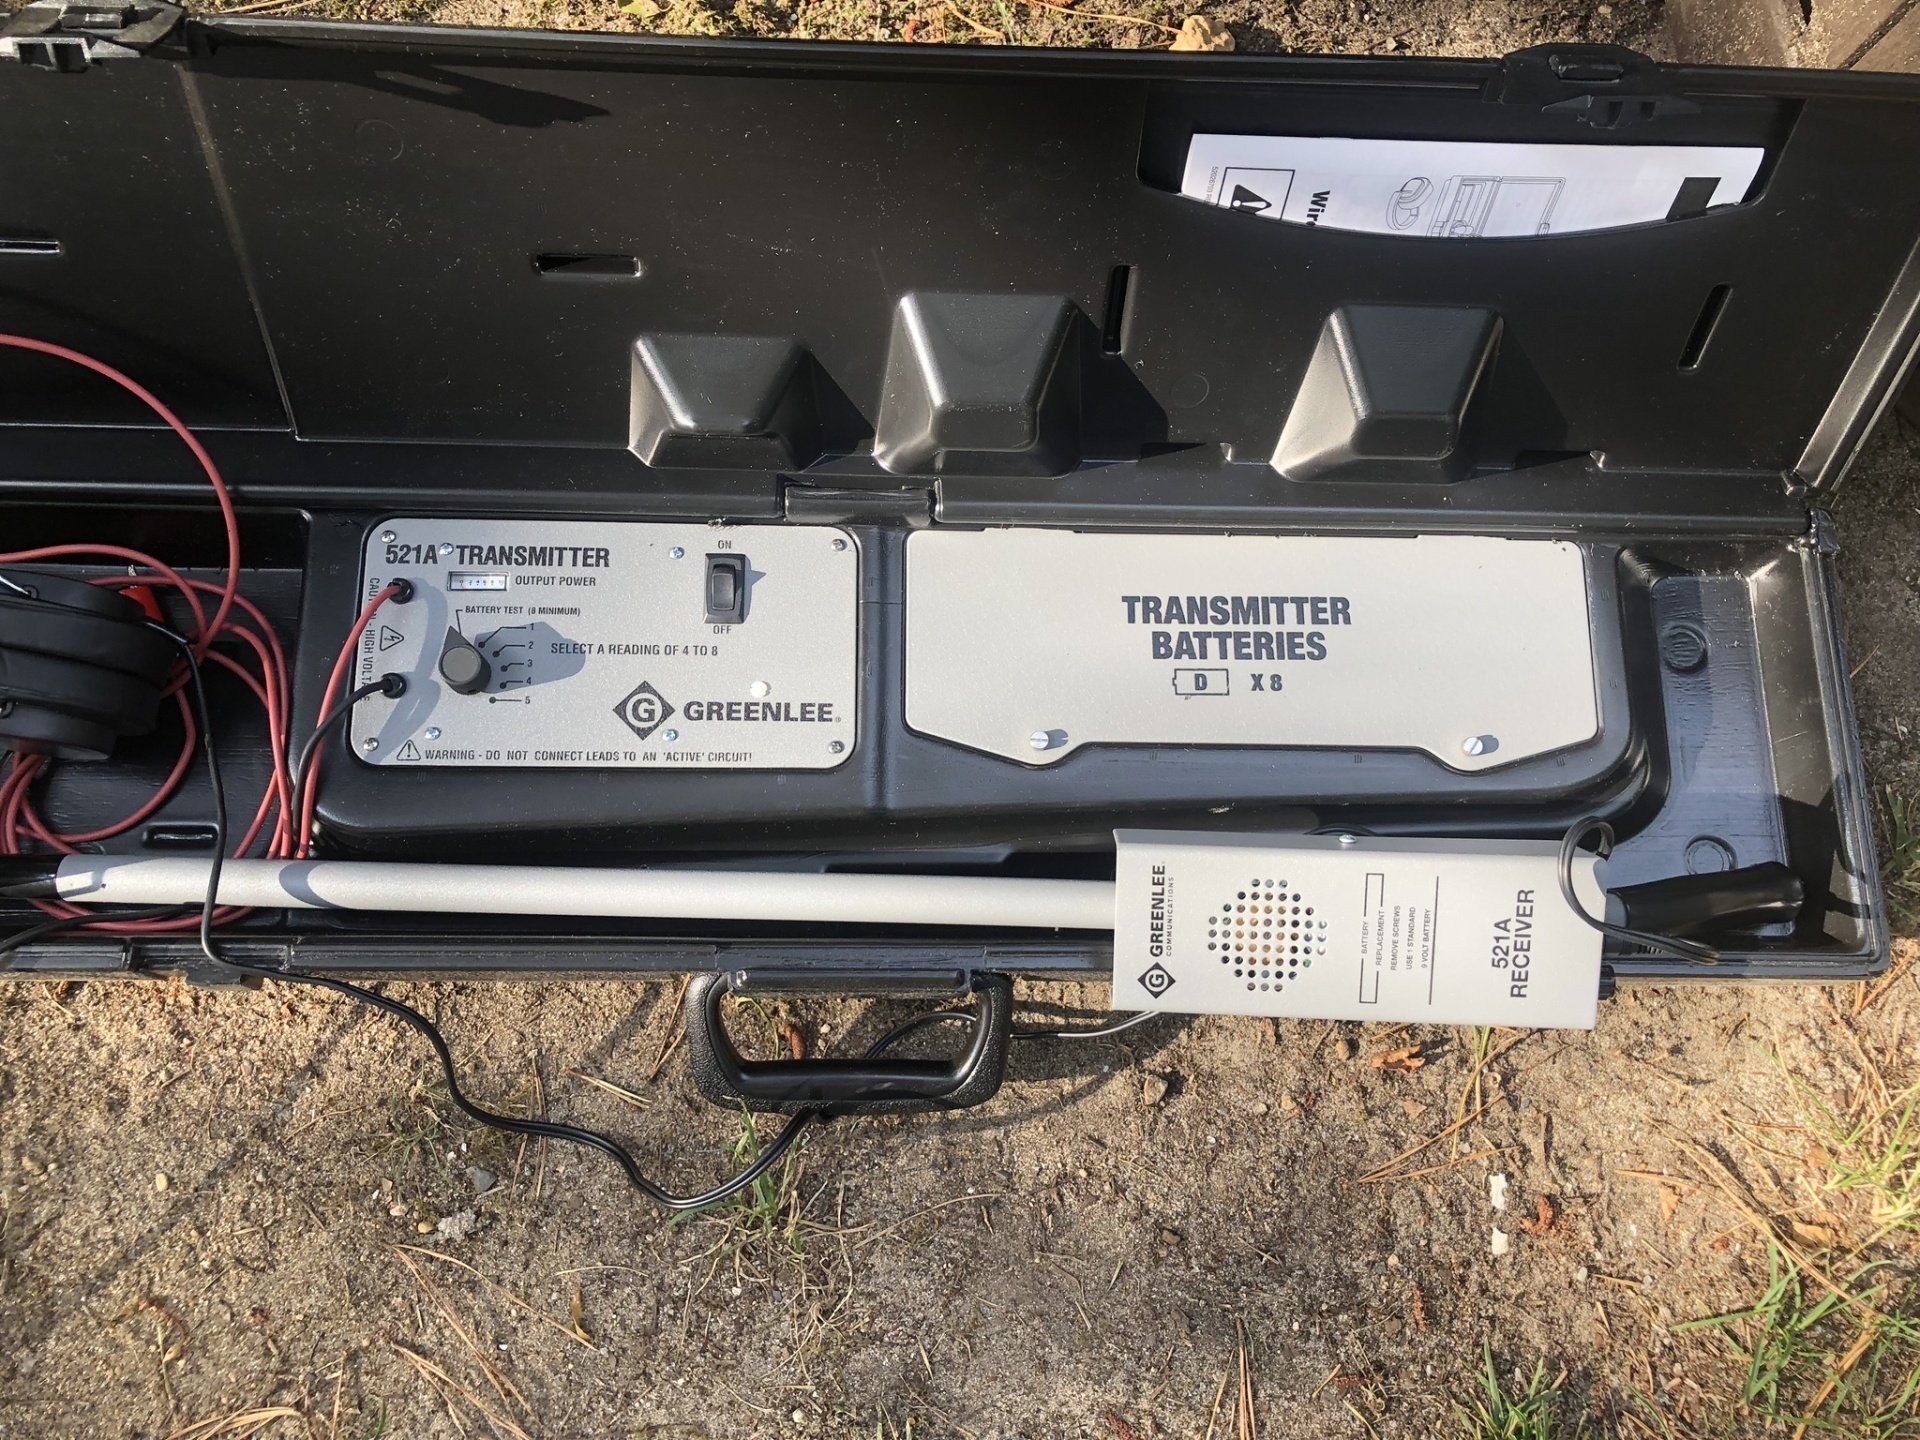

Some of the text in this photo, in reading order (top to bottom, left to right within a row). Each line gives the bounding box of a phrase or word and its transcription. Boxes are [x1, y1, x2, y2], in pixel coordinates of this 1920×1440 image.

[717, 540, 732, 550] ON
[385, 544, 609, 568] 521A TRANSMITTER
[515, 575, 597, 587] OUTPUT POWER
[465, 605, 581, 617] BATTERY TEST (8 MINIMUM)
[1121, 595, 1352, 625] TRANSMITTER
[529, 622, 535, 631] 1
[713, 624, 732, 635] OFF
[364, 629, 376, 654] HIGH
[528, 641, 534, 650] 2
[551, 642, 718, 657] SELECT A READING OF 4 TO 8
[1151, 631, 1328, 661] BATTERIES
[527, 659, 533, 668] 3
[526, 676, 532, 685] 4
[1194, 673, 1208, 691] D
[1250, 673, 1283, 692] X 8
[524, 696, 531, 705] 5
[631, 698, 656, 723] G
[683, 700, 834, 723] GREENLEE
[425, 749, 475, 761] WARNING
[485, 750, 501, 761] DO
[507, 750, 528, 761] NOT
[534, 750, 583, 761] CONNECT
[586, 750, 620, 762] LEADS
[623, 751, 637, 762] TO
[642, 751, 657, 762] AN
[663, 752, 705, 763] 'ACTIVE'
[707, 752, 752, 763] CIRCUIT!
[1149, 865, 1166, 957] GREENLEE
[1166, 876, 1174, 957] COMMUNICATIONS
[1407, 906, 1416, 948] STANDARD
[1422, 908, 1432, 942] BATTERY
[1361, 920, 1369, 955] BATTERY
[1376, 910, 1385, 966] REPLACEMENT
[1390, 905, 1401, 971] REMOVE SCREWS
[1491, 918, 1512, 969] 521A
[1510, 889, 1535, 998] RECEIVER
[1406, 955, 1414, 970] USE
[1421, 944, 1429, 962] VOLT
